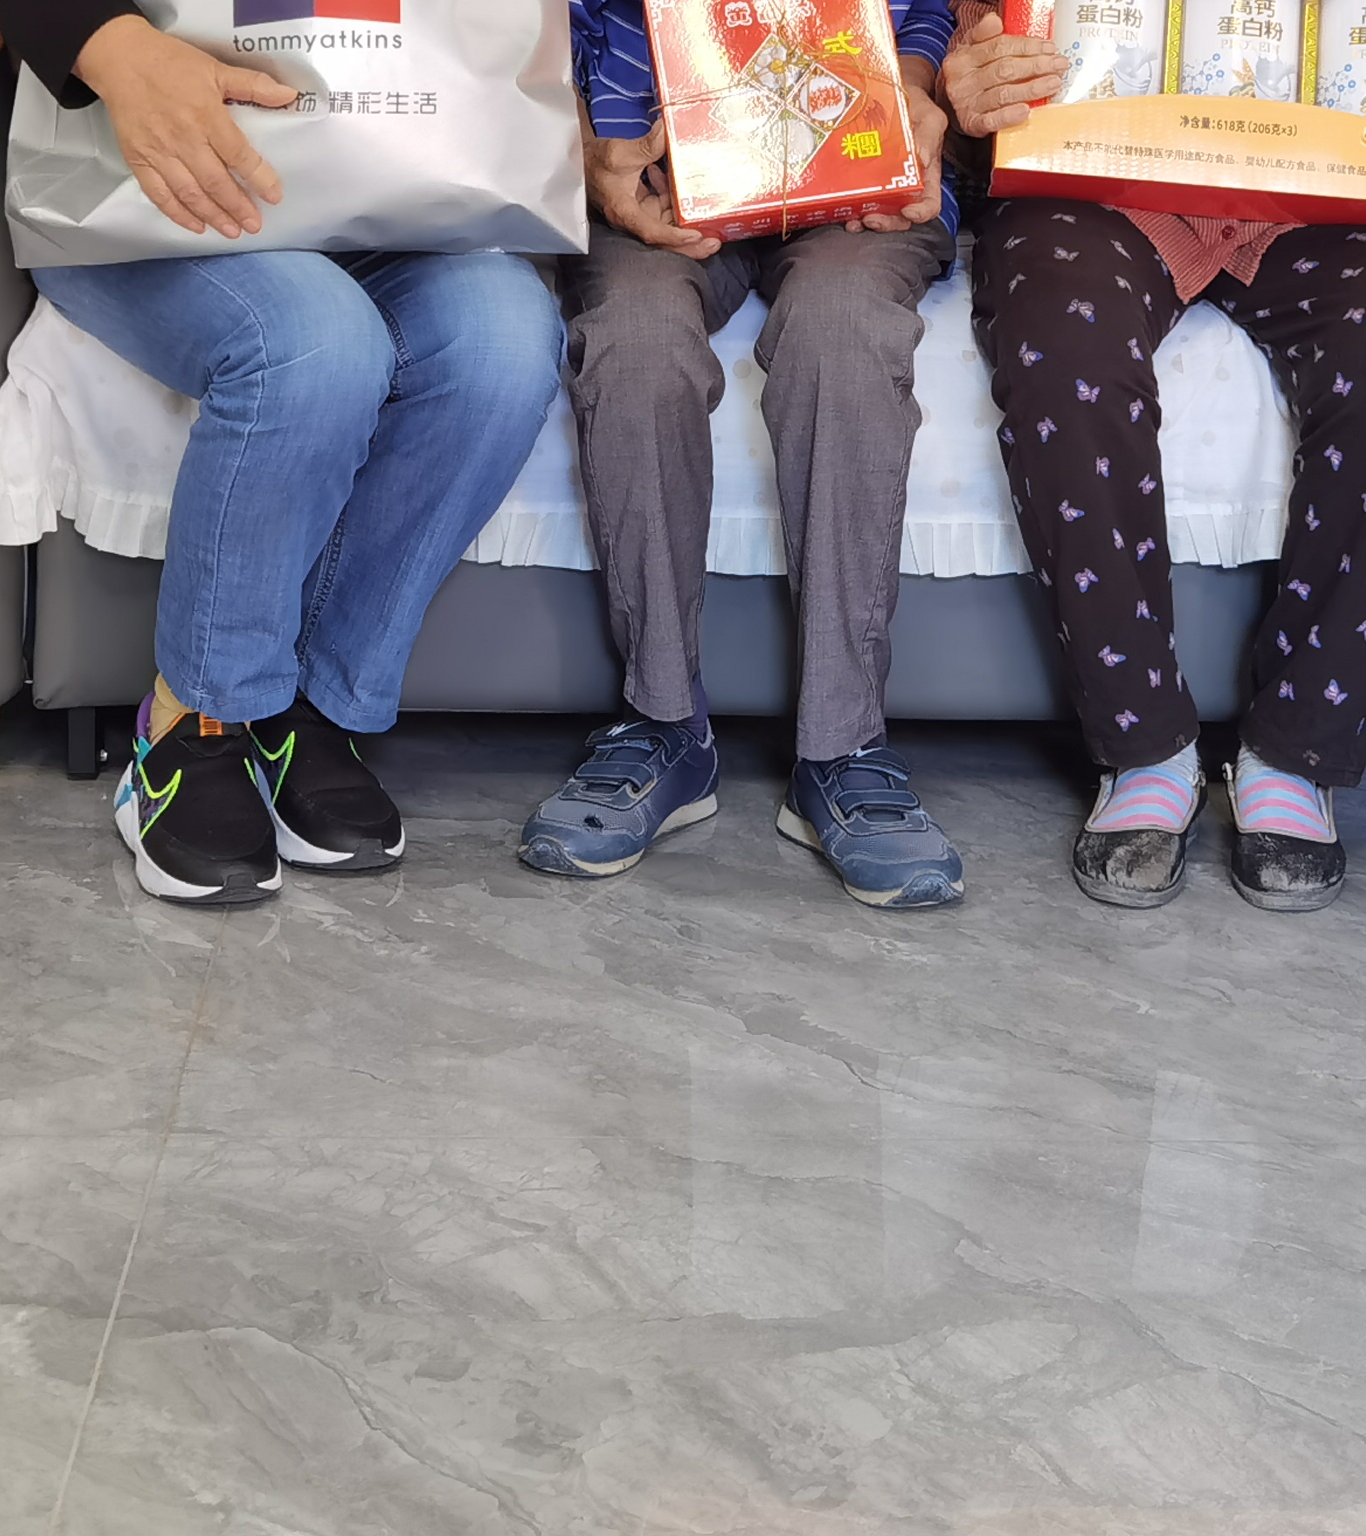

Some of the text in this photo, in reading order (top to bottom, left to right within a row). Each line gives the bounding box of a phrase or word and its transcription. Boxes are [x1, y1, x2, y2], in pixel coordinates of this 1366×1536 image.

[1076, 4, 1144, 29] 蛋白粉
[1217, 15, 1284, 42] 蛋白粉
[232, 30, 403, 54] tommyatkins
[822, 30, 863, 55] 式
[328, 91, 438, 115] 精彩生活
